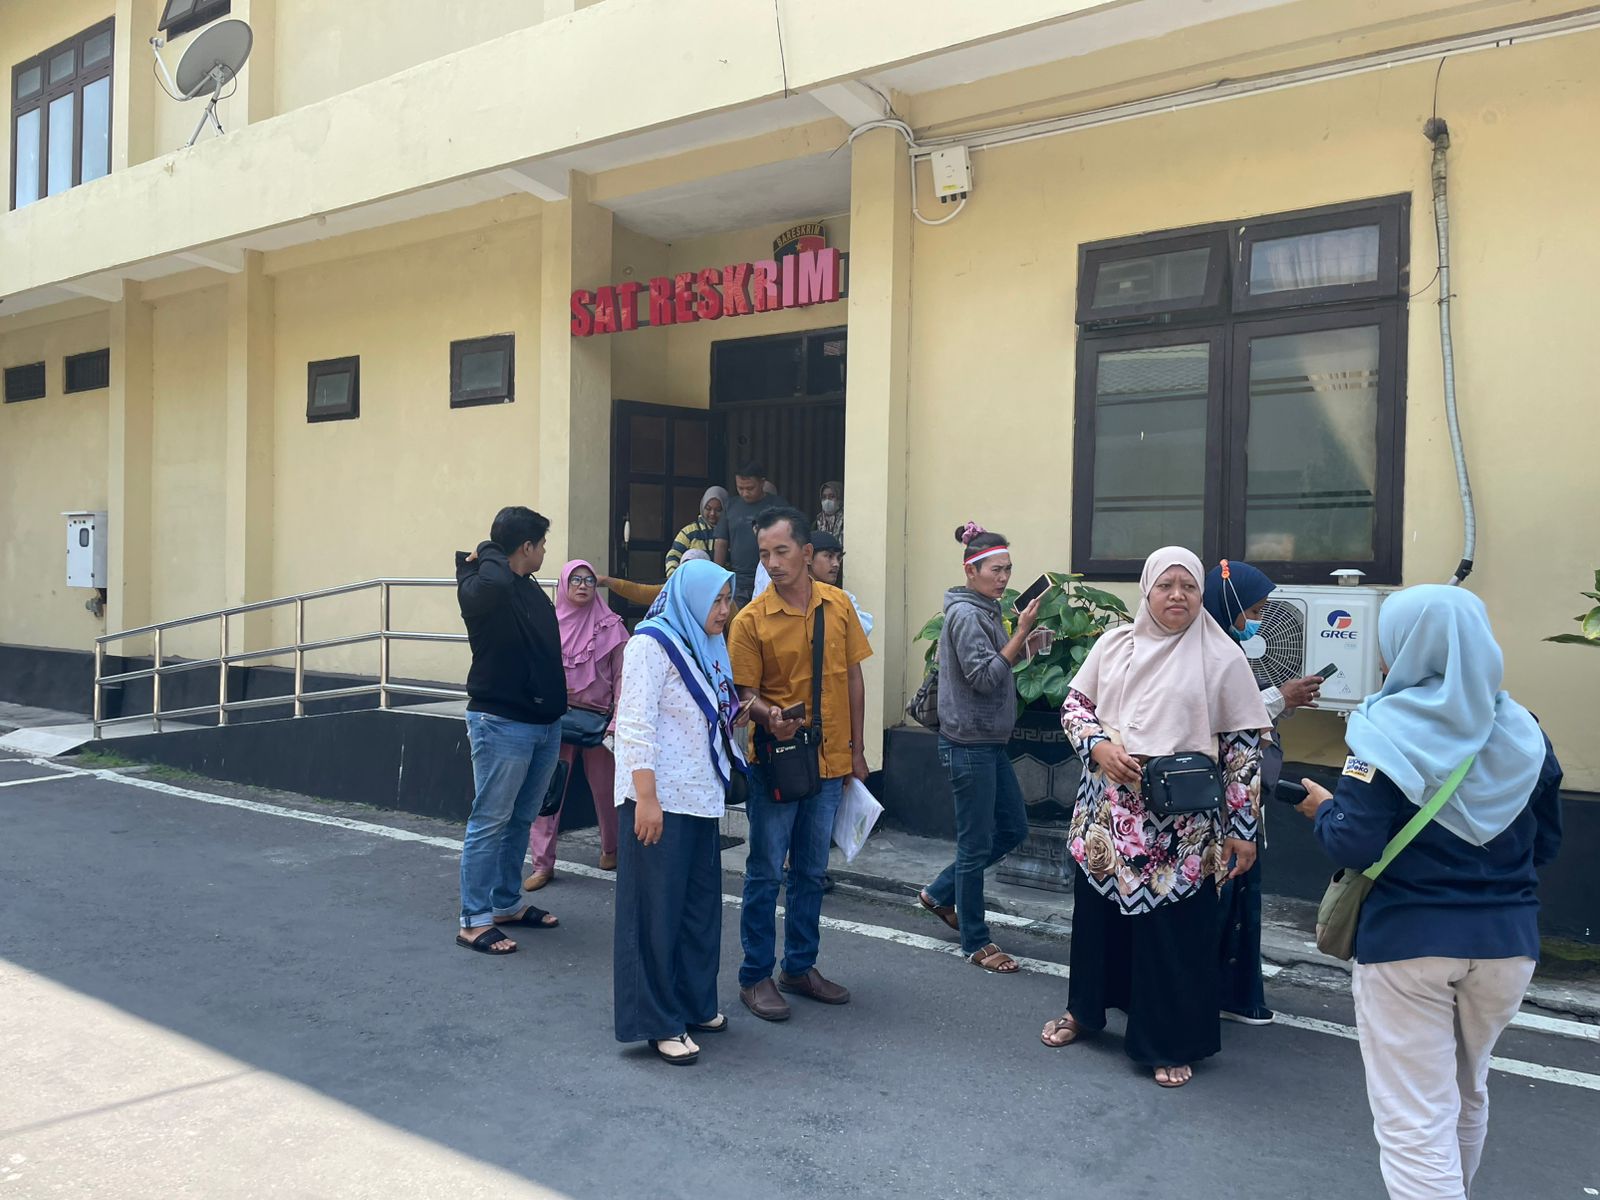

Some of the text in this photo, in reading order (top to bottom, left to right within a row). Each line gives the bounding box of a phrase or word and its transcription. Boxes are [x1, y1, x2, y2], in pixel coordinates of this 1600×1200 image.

[776, 224, 821, 247] BARESKRIM
[571, 247, 839, 336] SAT RESKRIM
[1320, 630, 1358, 639] GREE
